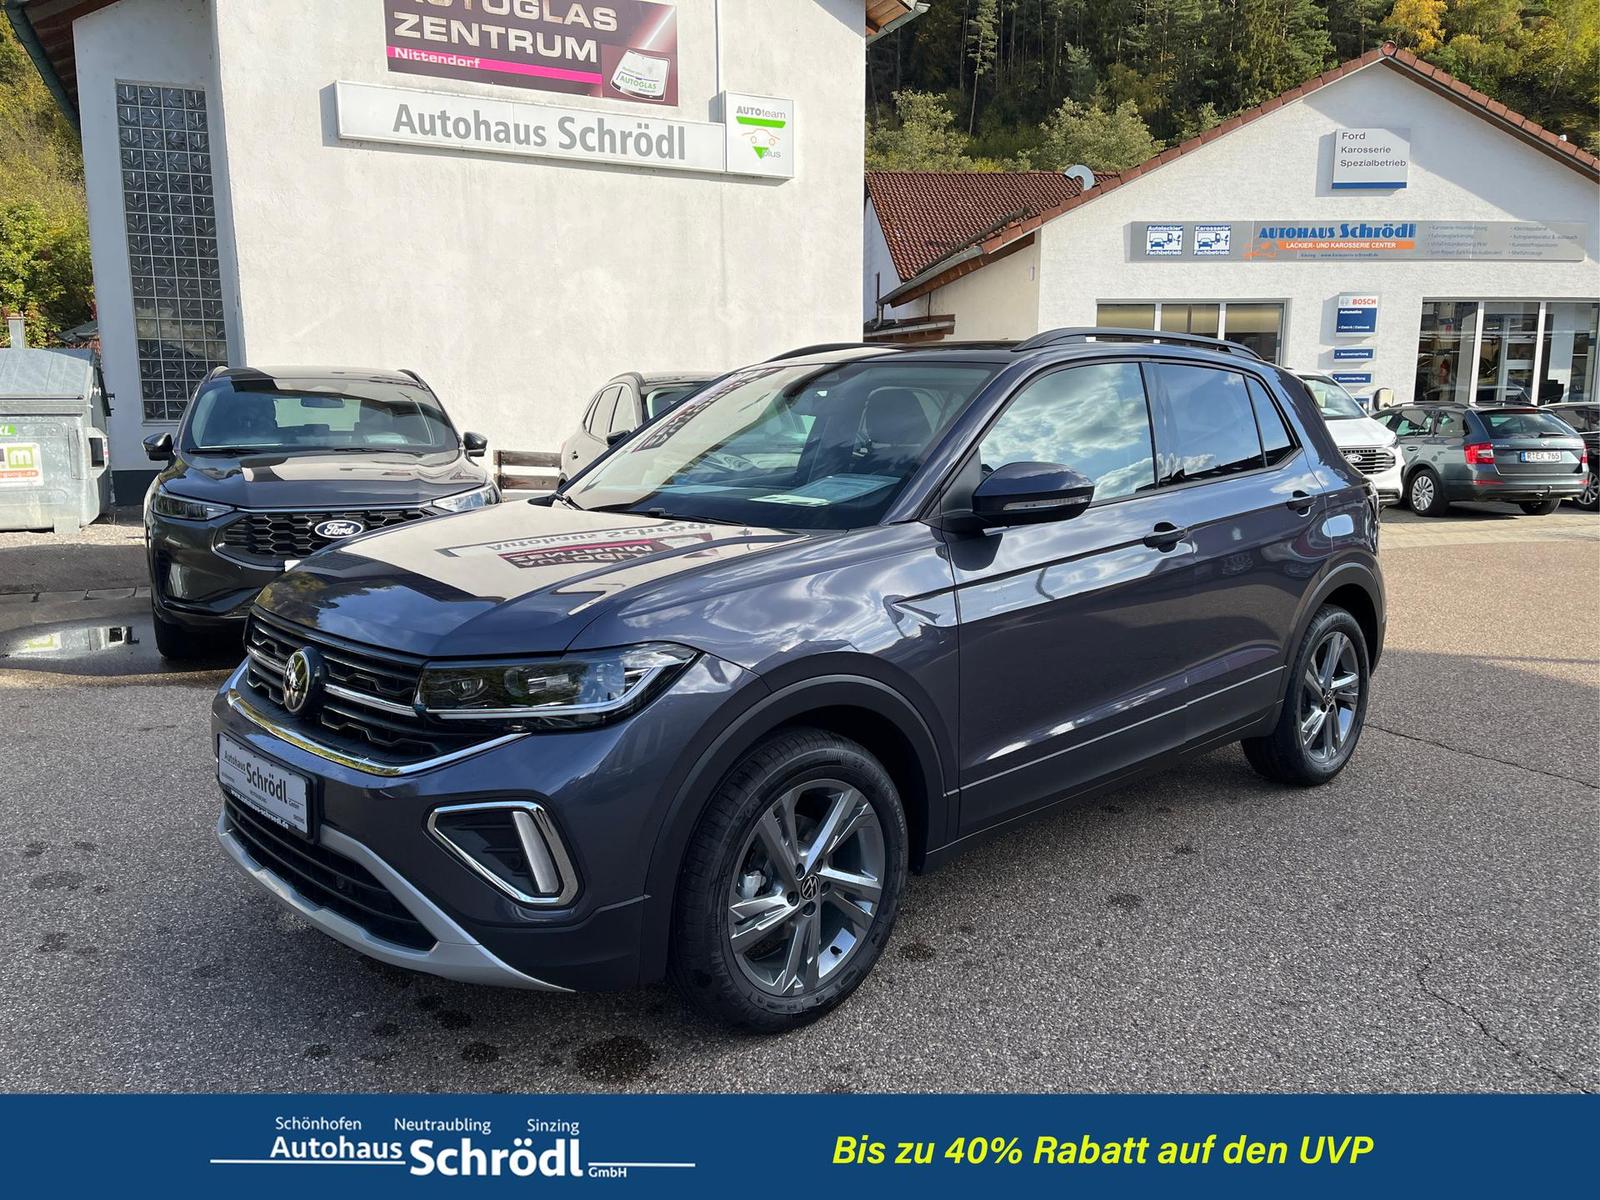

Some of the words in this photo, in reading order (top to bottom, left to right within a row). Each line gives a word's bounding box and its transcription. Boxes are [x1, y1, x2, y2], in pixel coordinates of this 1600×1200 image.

[393, 11, 598, 63] ZENTRUM
[394, 47, 481, 69] Nittendorf
[736, 105, 786, 119] AUTOteam
[392, 103, 548, 147] Autohaus
[557, 116, 686, 160] Schrödl
[1341, 131, 1366, 140] Ford
[1340, 146, 1392, 154] Karosserie
[1340, 159, 1407, 168] Spezialbetrieb
[1259, 226, 1336, 239] AUTOHAUS
[1338, 223, 1417, 239] Schrödl
[324, 522, 355, 536] Ford
[246, 762, 288, 804] Schrödl
